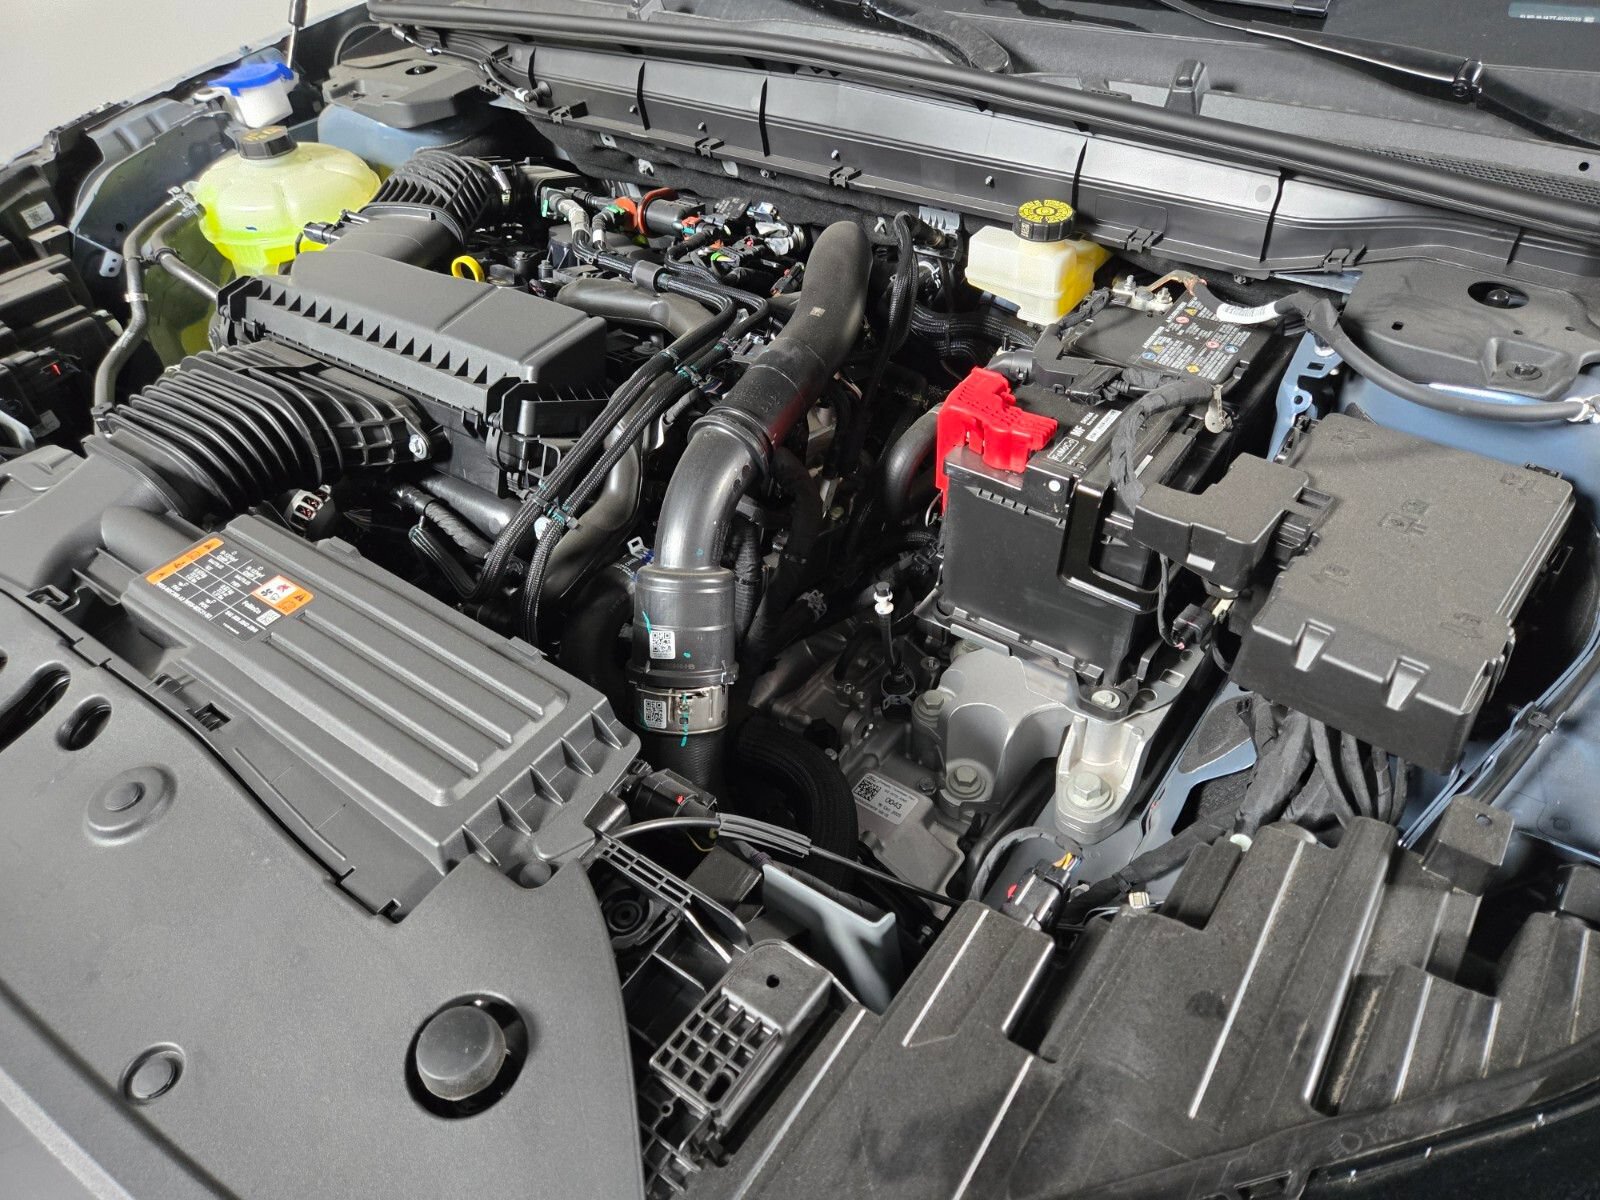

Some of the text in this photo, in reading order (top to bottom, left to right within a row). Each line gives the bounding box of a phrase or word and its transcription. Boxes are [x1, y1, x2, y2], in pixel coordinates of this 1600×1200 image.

[1052, 438, 1076, 461] FoMoCo
[1070, 425, 1085, 437] MF
[885, 797, 902, 809] 0043
